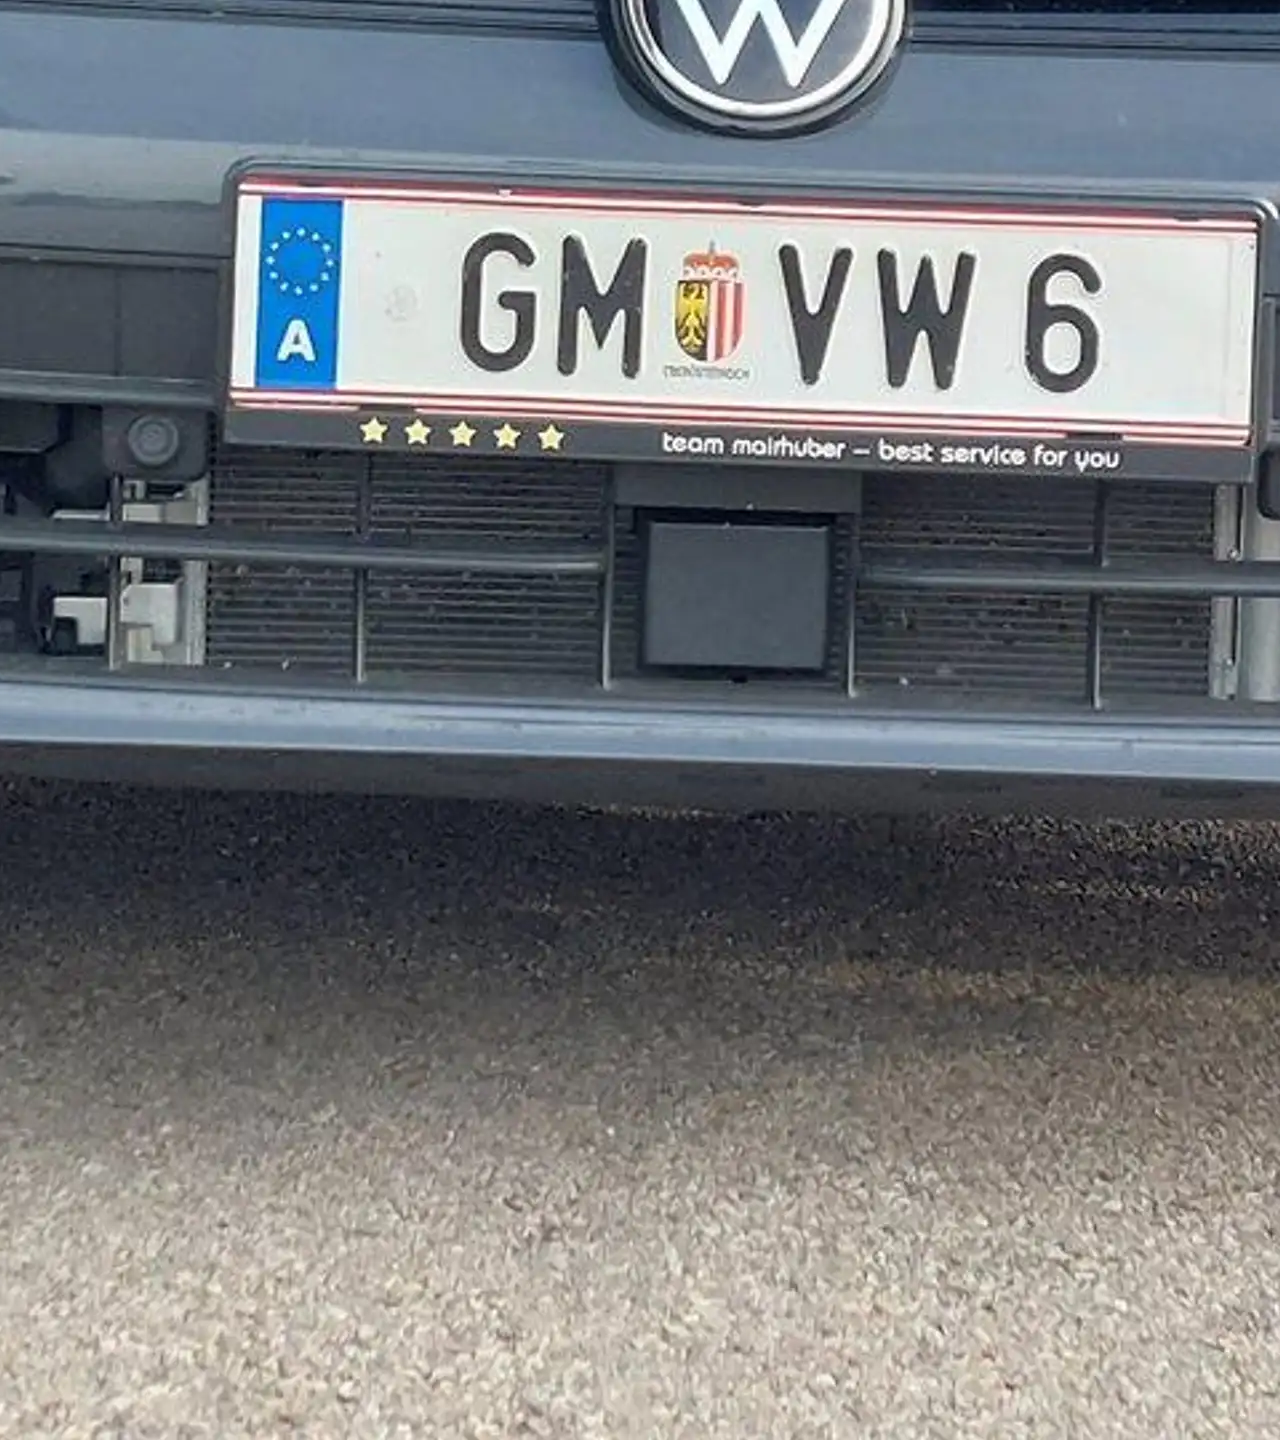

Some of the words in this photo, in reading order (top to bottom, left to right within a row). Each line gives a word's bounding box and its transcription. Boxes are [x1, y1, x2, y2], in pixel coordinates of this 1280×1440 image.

[459, 231, 648, 380] GM
[777, 243, 977, 392] VW
[1024, 252, 1102, 394] 6
[276, 318, 317, 362] A
[662, 431, 725, 454] team
[731, 434, 847, 459] mairhuber
[877, 436, 934, 462] best
[939, 442, 1028, 466] service
[1033, 443, 1068, 467] for
[1074, 450, 1121, 473] you
